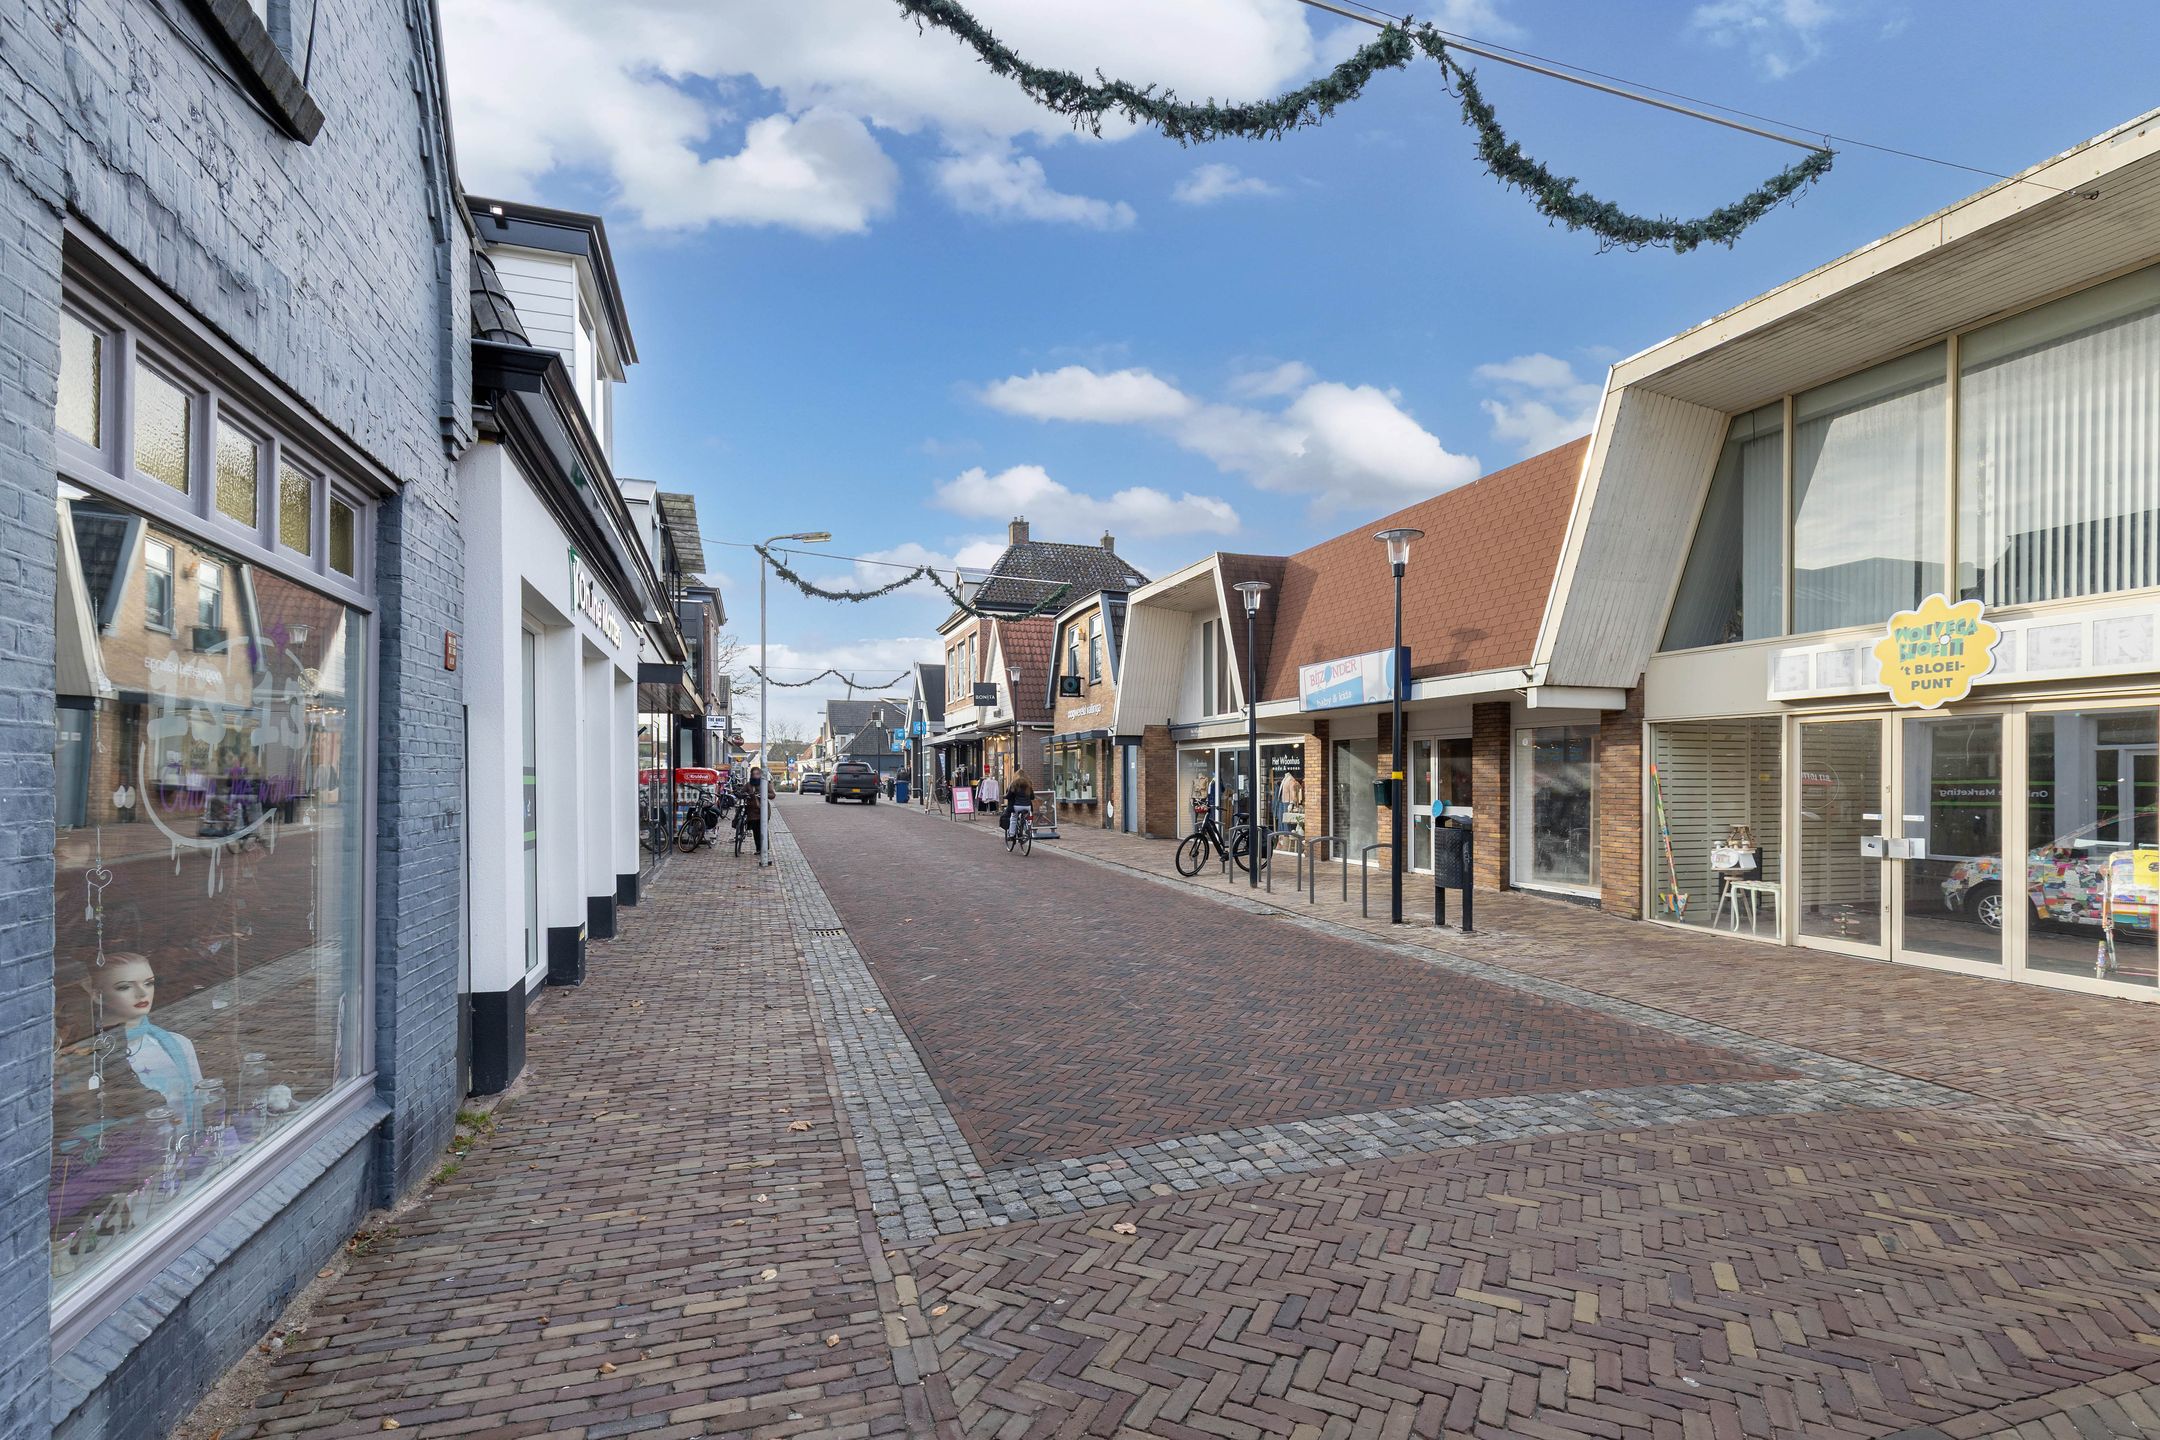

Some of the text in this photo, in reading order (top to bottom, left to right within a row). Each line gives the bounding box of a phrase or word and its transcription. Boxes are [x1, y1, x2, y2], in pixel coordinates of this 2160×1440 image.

[1895, 618, 1978, 641] WOLVEGA
[1911, 678, 1953, 690] PUNT
[1271, 757, 1279, 765] Het
